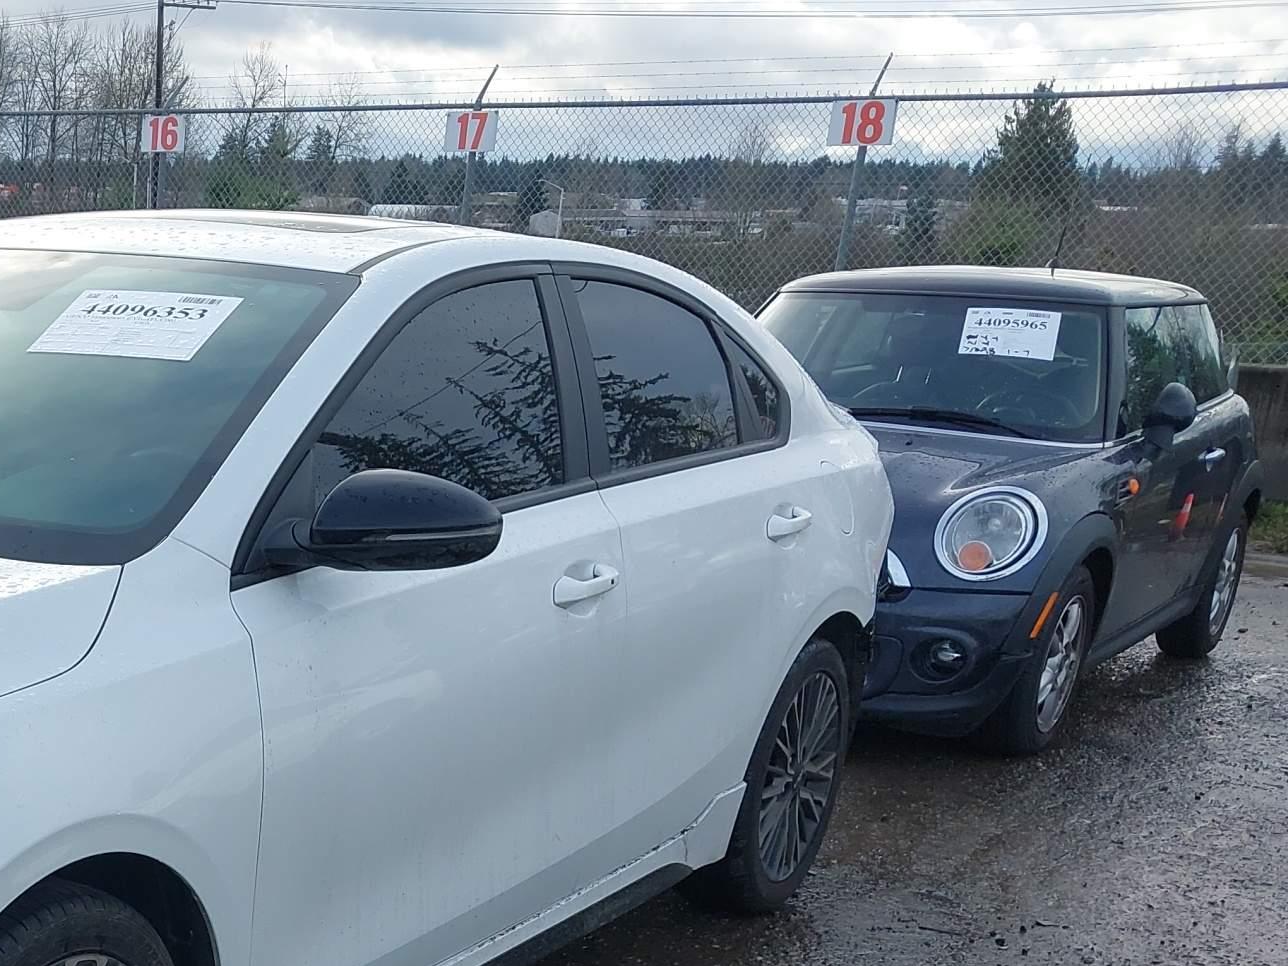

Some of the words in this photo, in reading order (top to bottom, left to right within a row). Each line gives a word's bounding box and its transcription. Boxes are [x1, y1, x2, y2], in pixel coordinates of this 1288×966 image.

[149, 116, 179, 151] 16
[456, 112, 489, 150] 17
[841, 100, 886, 144] 18
[81, 303, 209, 321] 44096353
[974, 318, 1048, 331] 44095965
